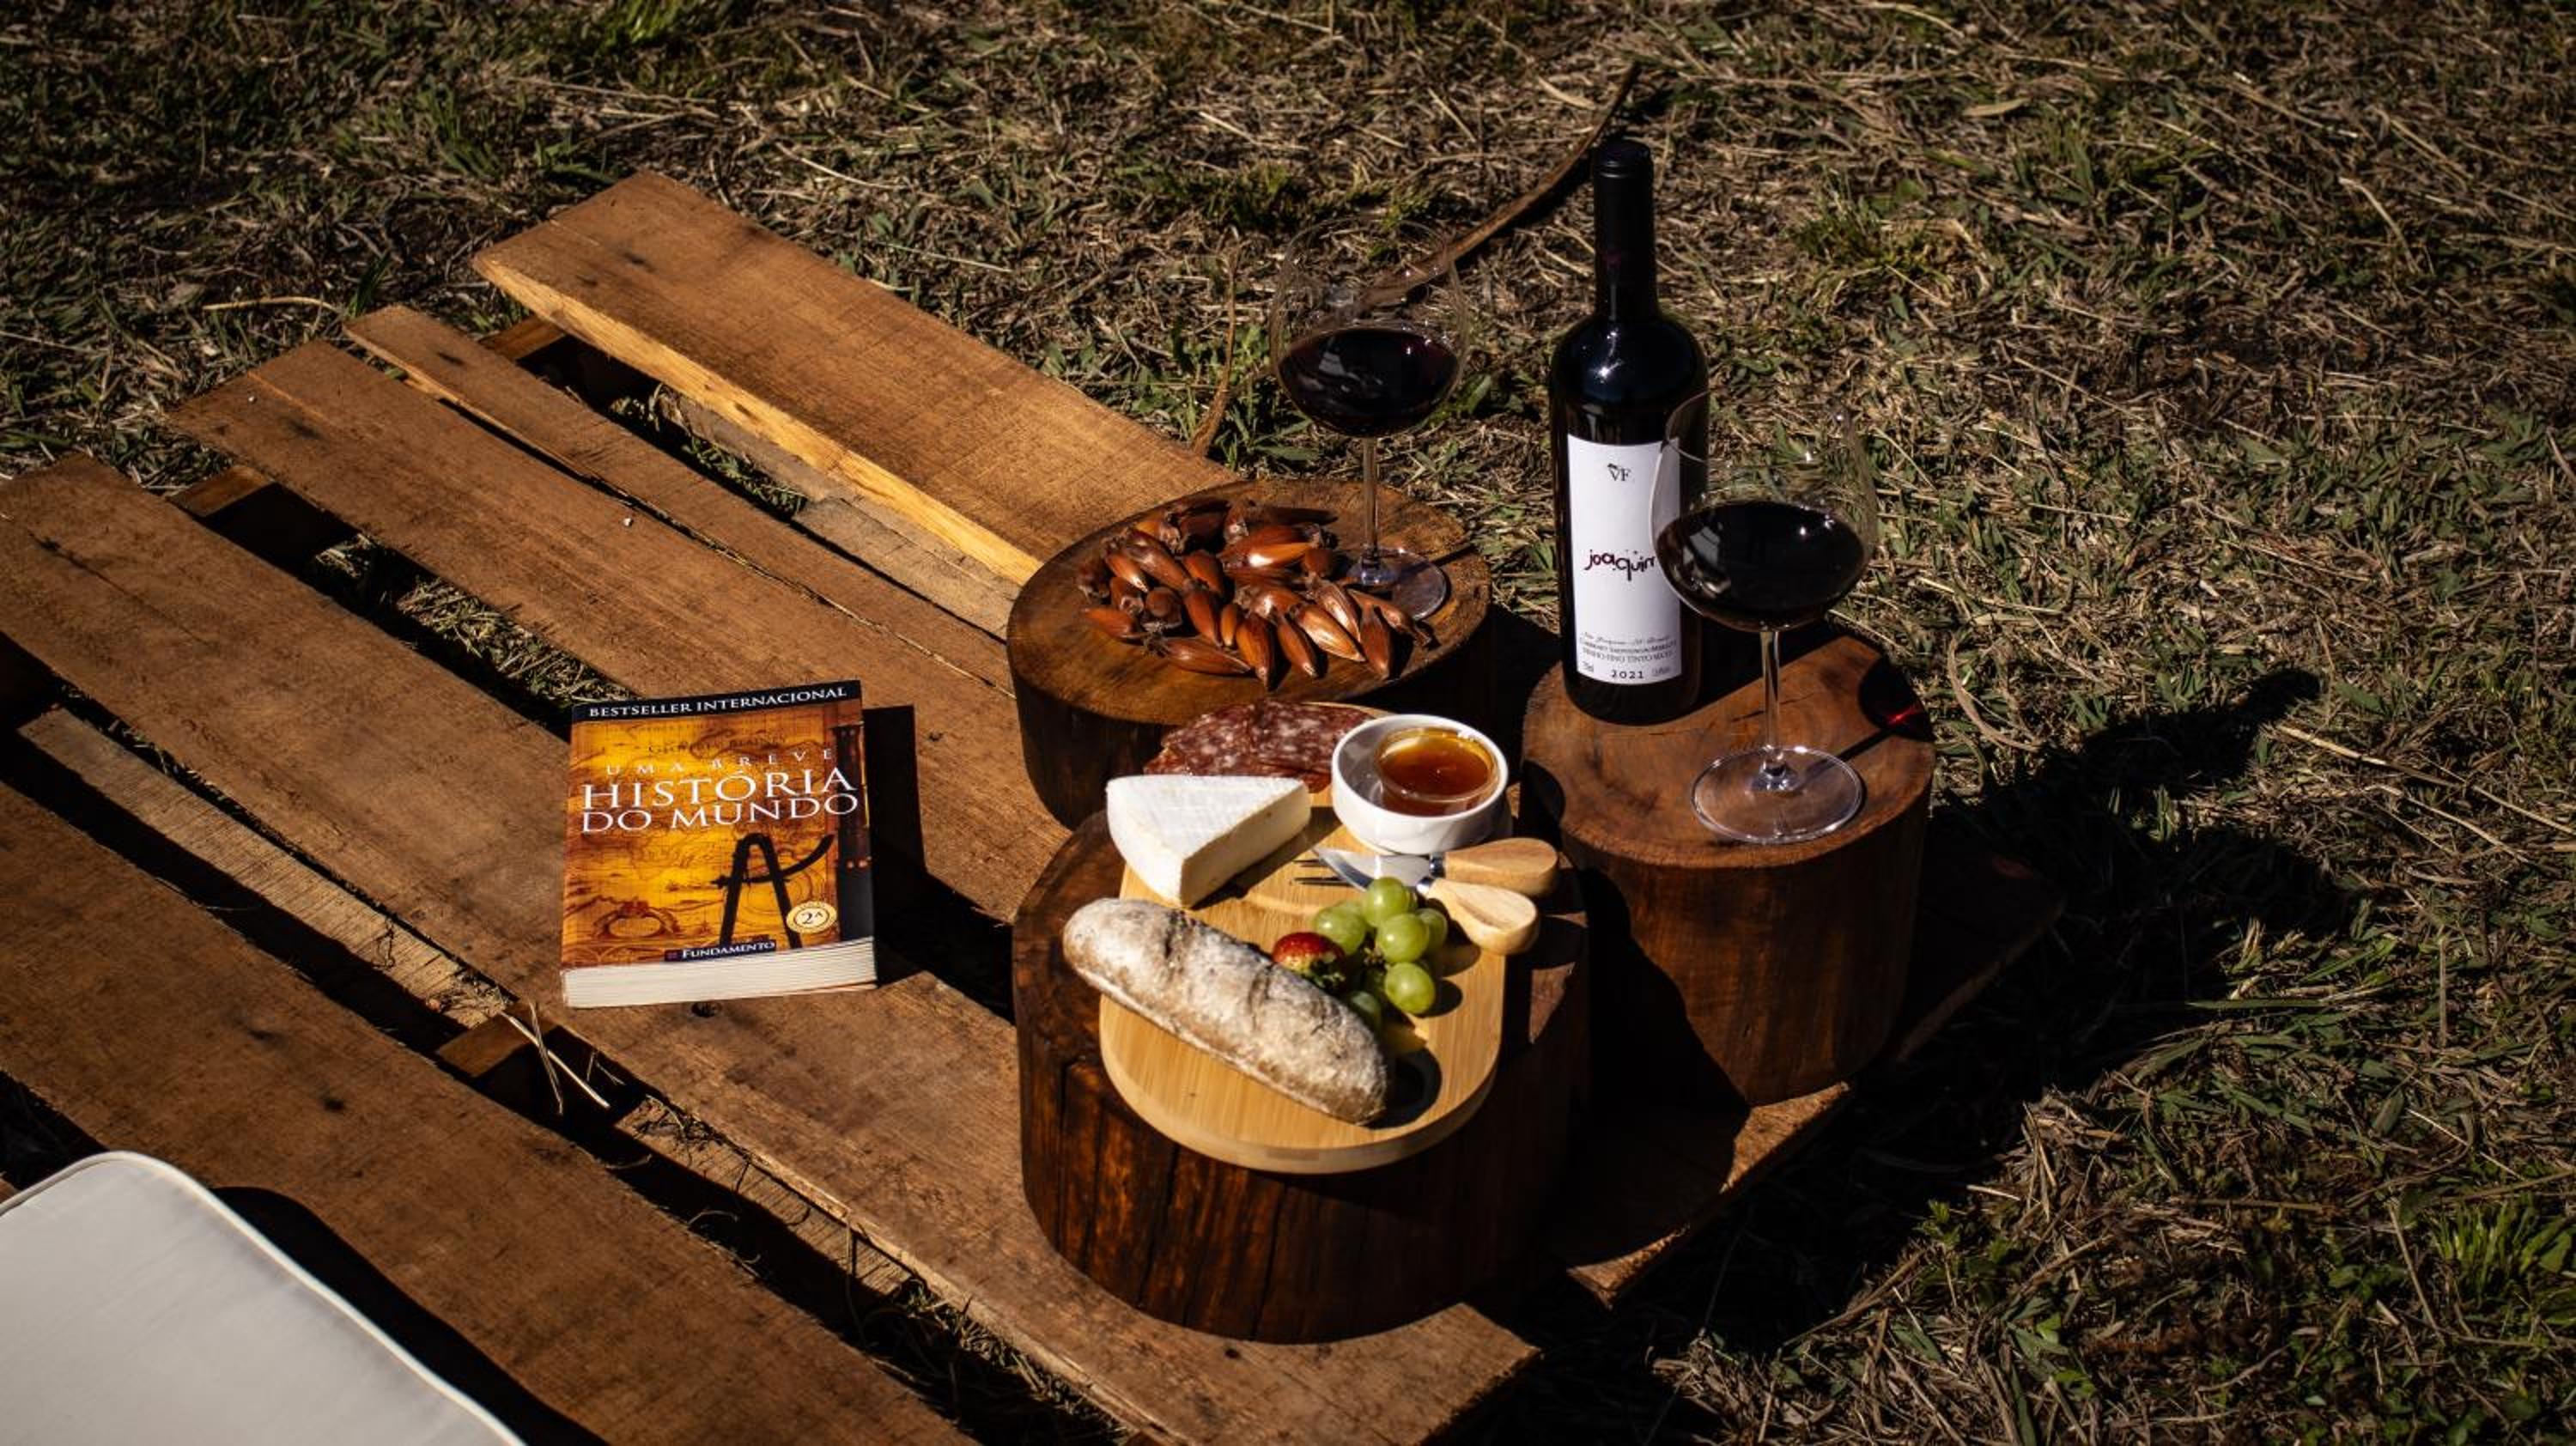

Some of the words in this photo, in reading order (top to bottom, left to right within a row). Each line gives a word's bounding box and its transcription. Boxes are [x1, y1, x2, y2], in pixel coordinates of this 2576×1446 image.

[1611, 669, 1644, 679] 2021
[589, 702, 692, 718] BESTSELLER
[696, 687, 848, 711] INTERNACIONAL
[606, 762, 685, 775] UMA
[712, 749, 833, 769] BREVE
[581, 766, 858, 810] HISTÓRIA
[581, 810, 651, 833] DO
[671, 793, 859, 829] MUNDO
[682, 941, 775, 959] FUNDAMENTO
